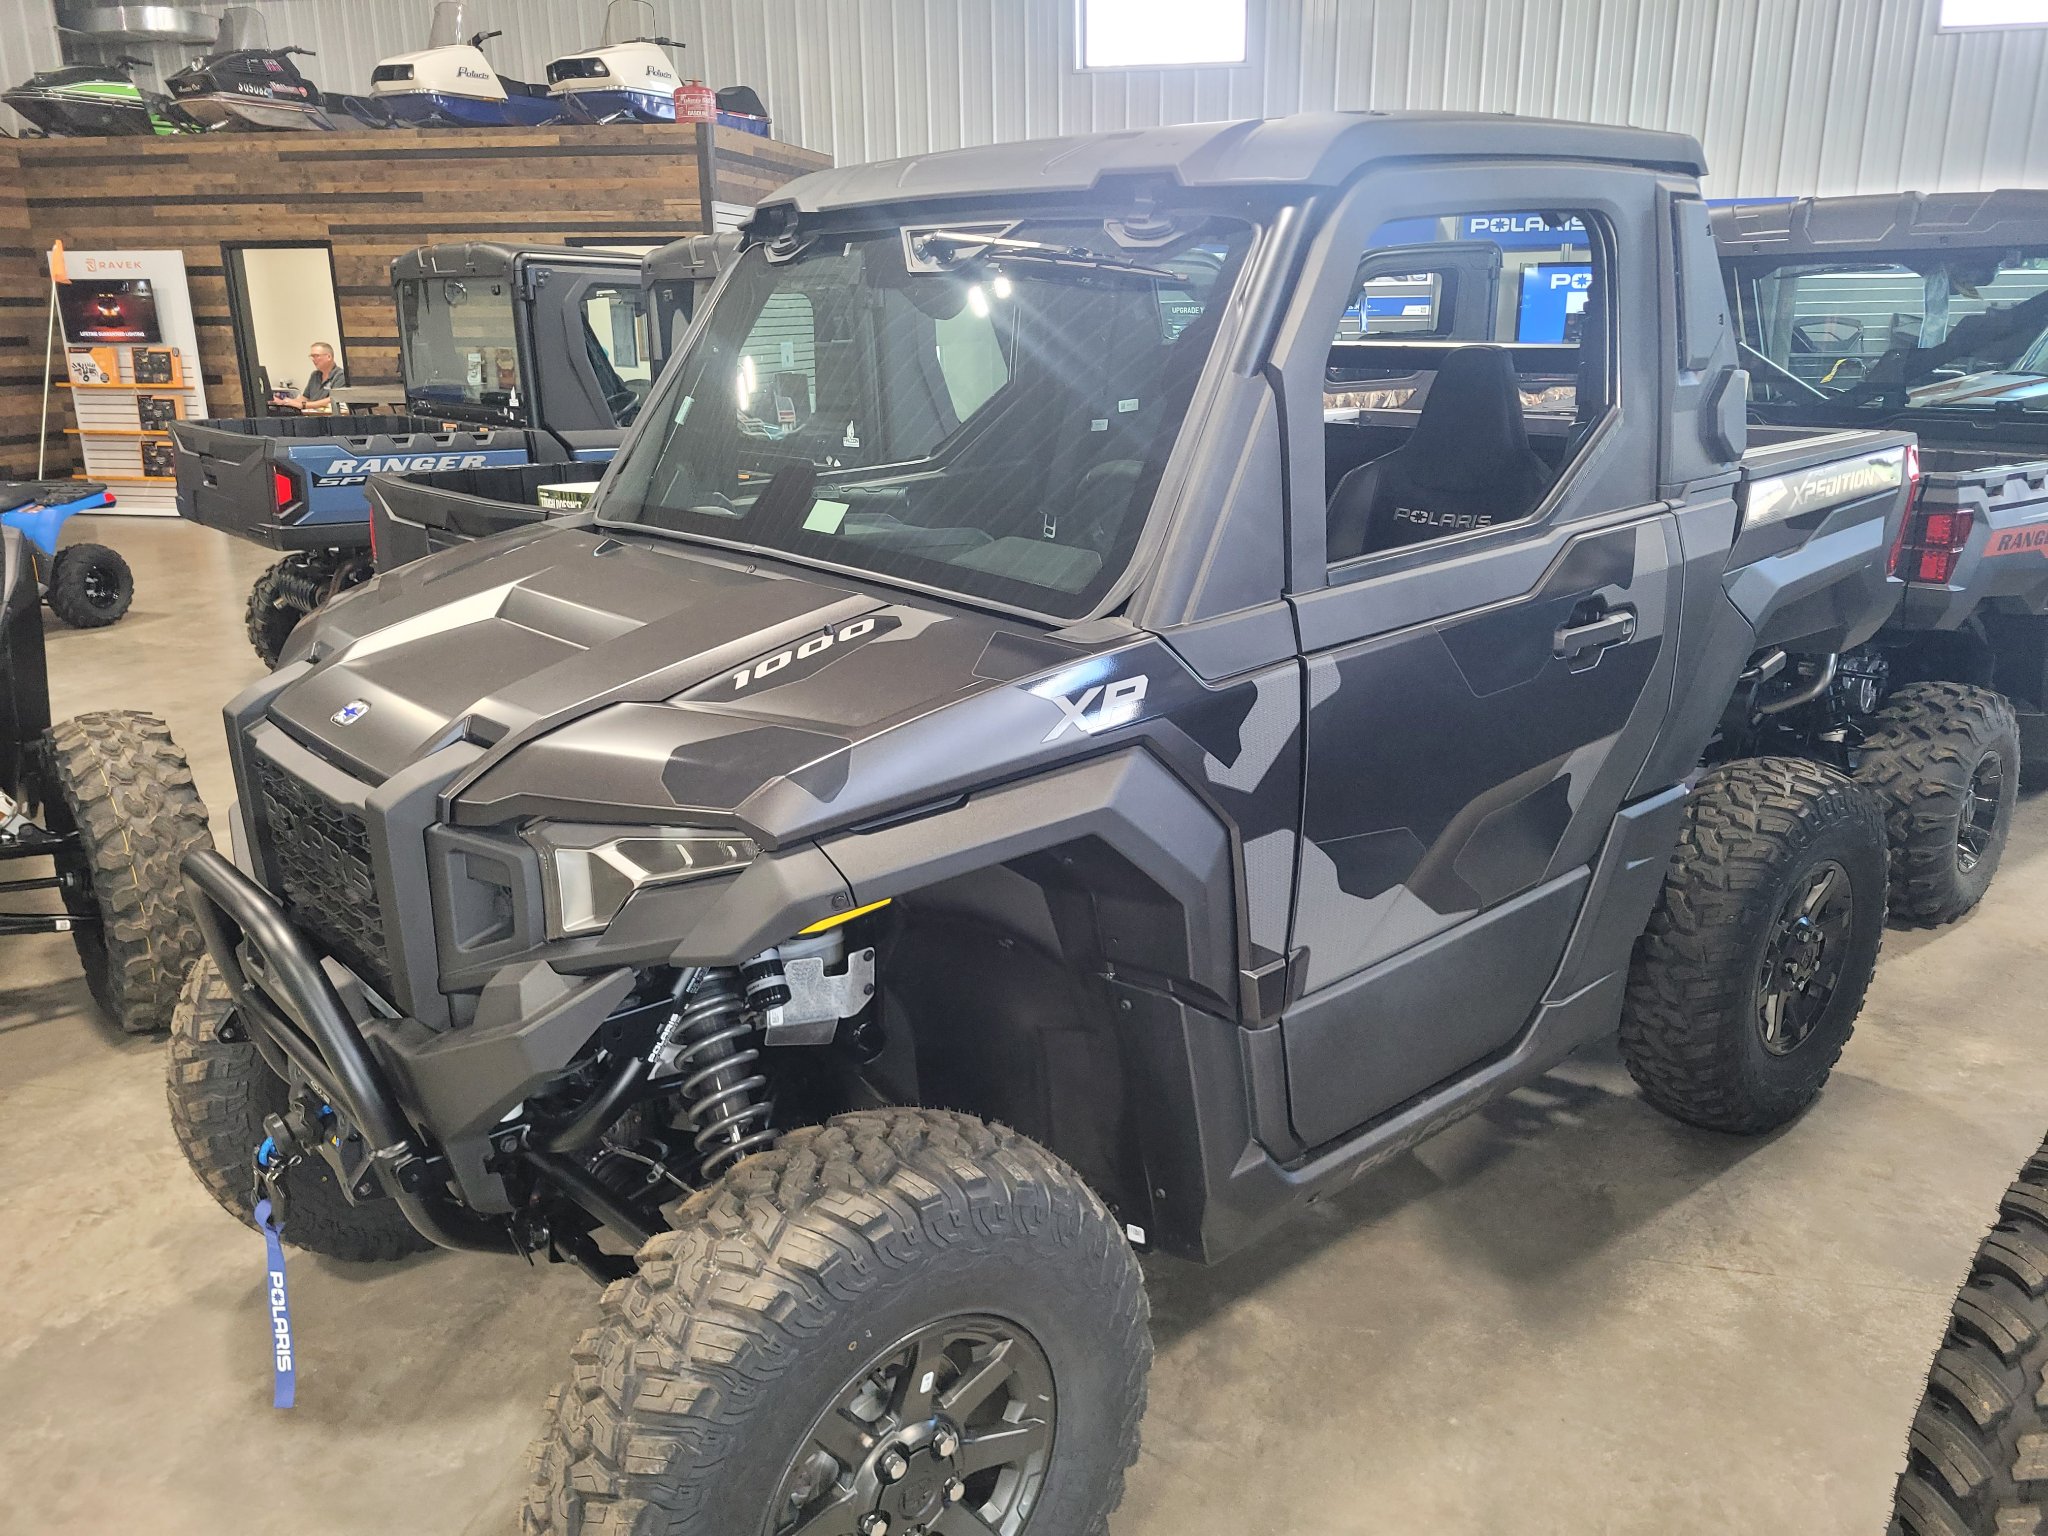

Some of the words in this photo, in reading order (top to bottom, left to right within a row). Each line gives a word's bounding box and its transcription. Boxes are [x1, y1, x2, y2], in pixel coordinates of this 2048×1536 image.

[98, 261, 144, 270] RAVEK
[1171, 306, 1200, 314] UPGRADE
[326, 455, 487, 475] RANGER
[316, 476, 365, 487] SP
[1787, 467, 1876, 512] XPEDITION
[1393, 506, 1492, 529] POLARIS
[1997, 529, 2048, 552] RANG
[733, 618, 875, 691] 1000
[1040, 674, 1149, 743] XP
[647, 1012, 679, 1063] POLARIS
[269, 1270, 293, 1373] POLARIS
